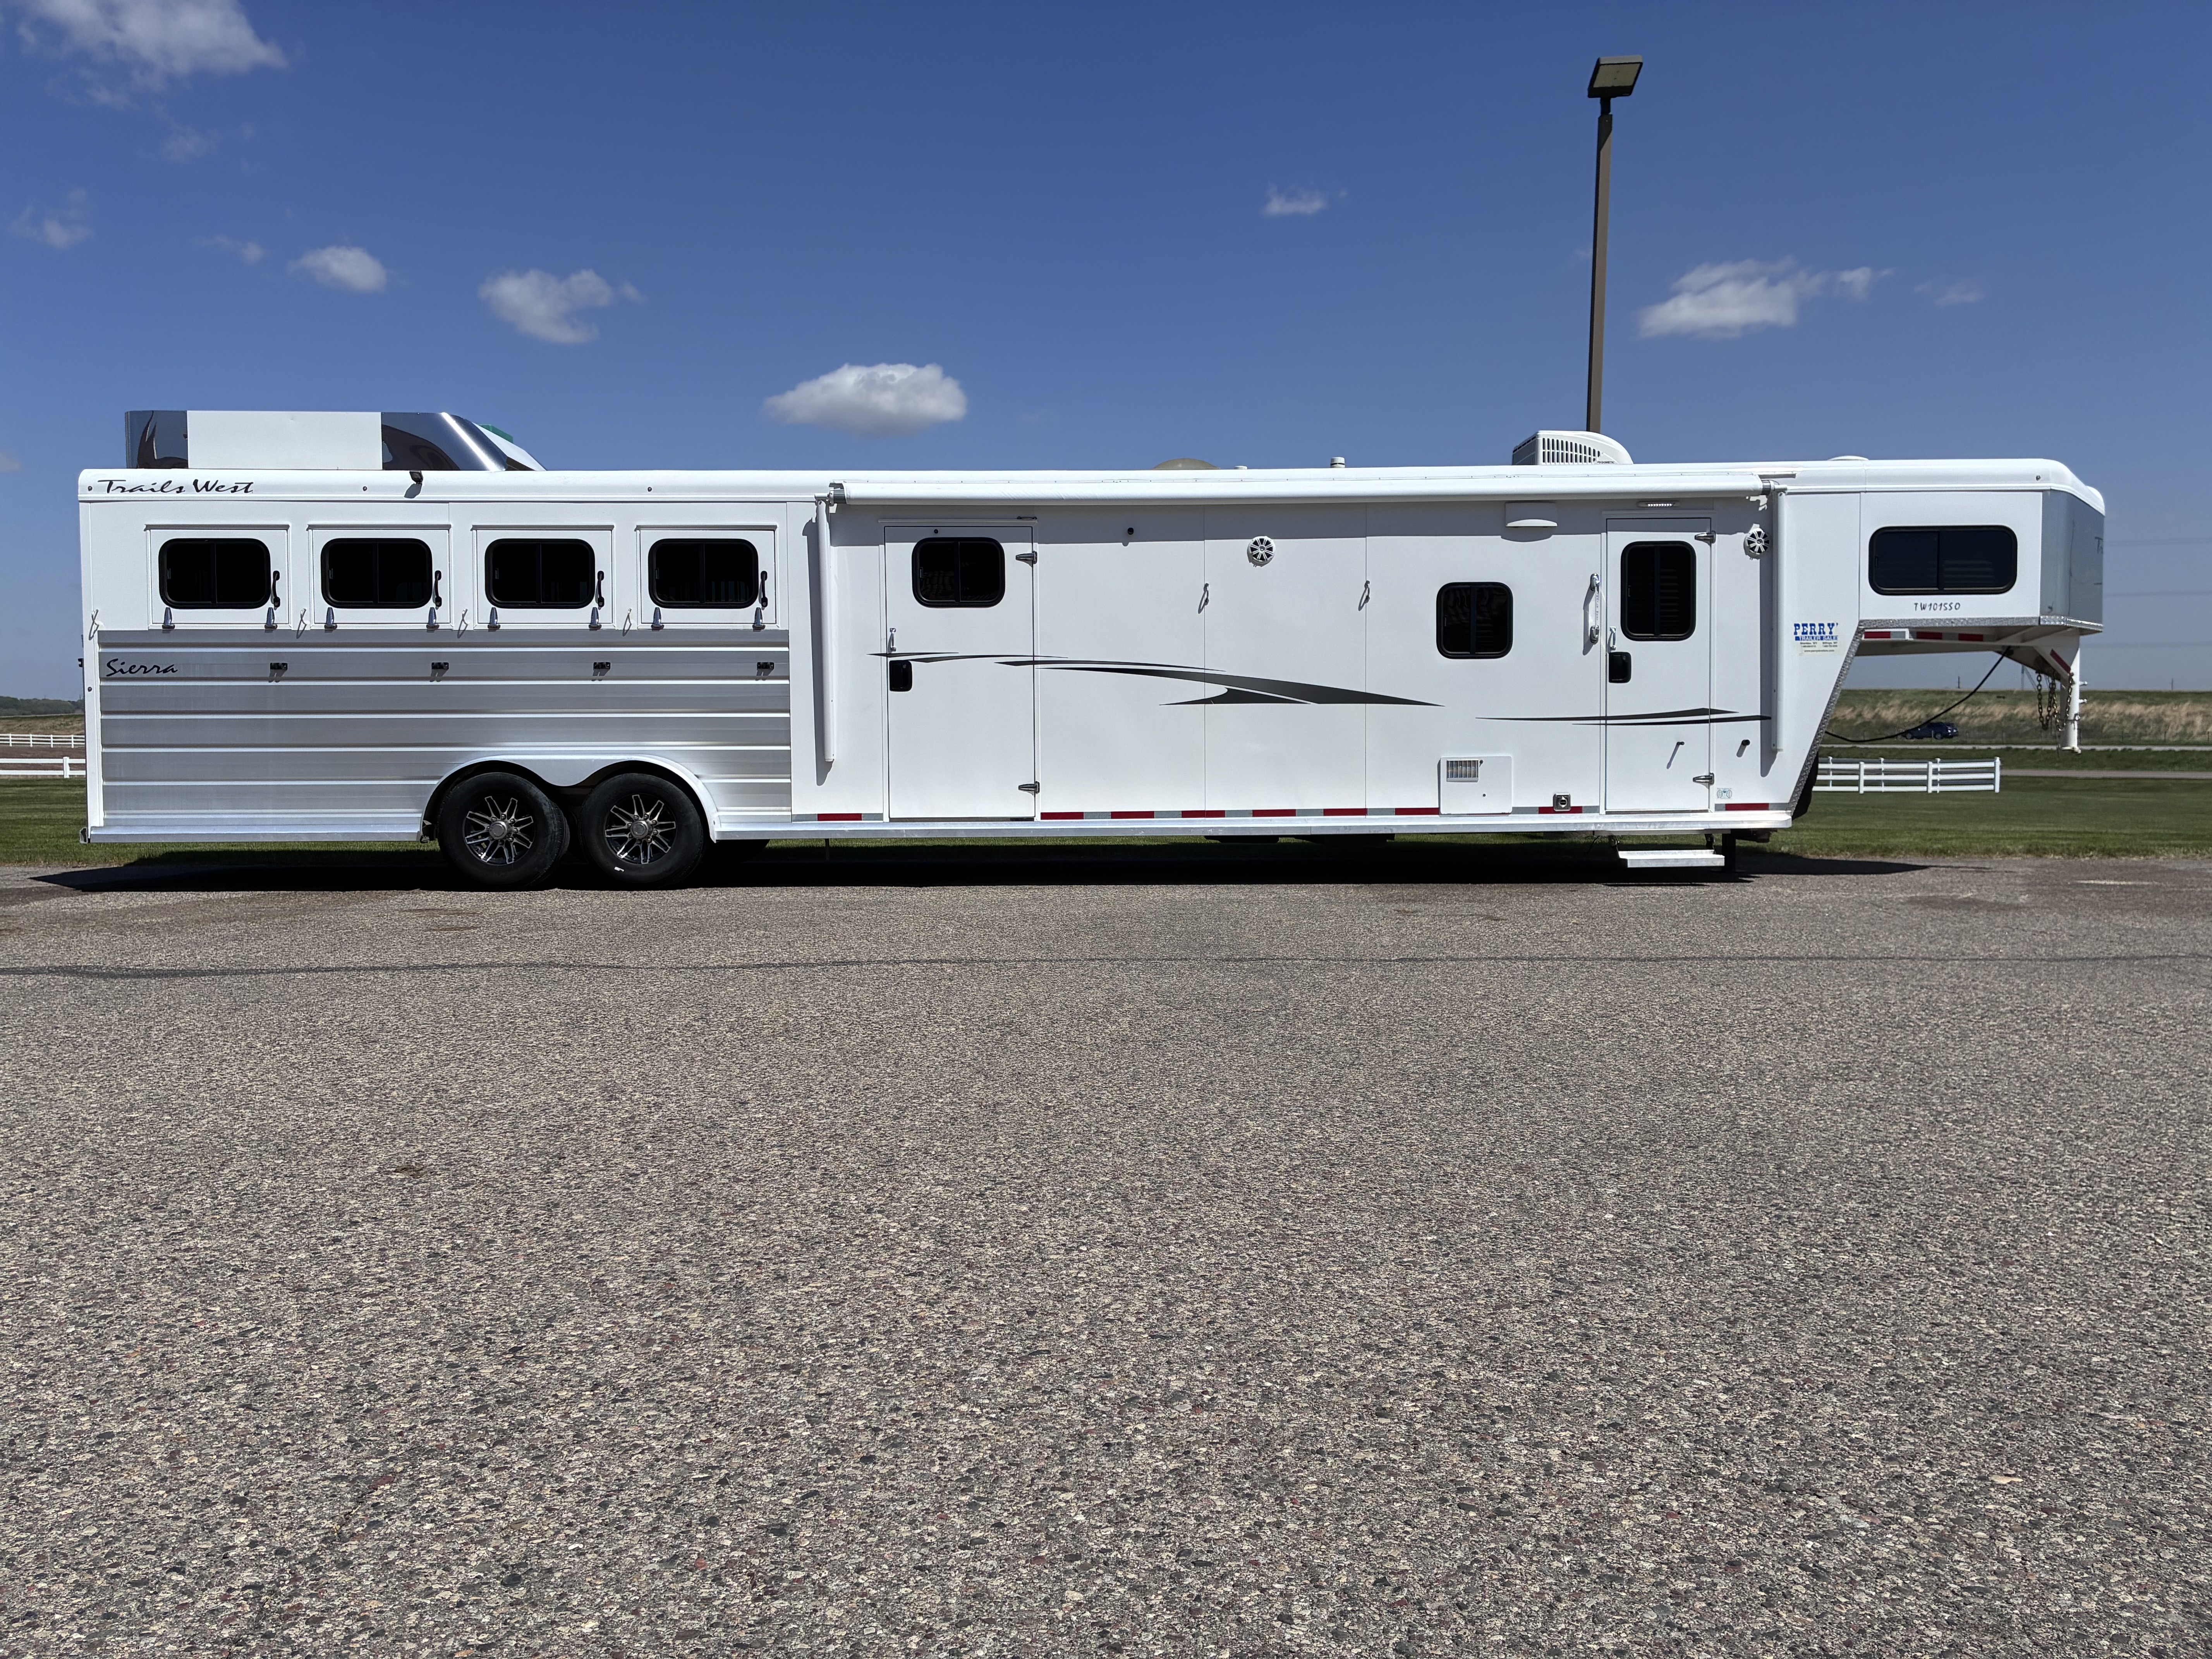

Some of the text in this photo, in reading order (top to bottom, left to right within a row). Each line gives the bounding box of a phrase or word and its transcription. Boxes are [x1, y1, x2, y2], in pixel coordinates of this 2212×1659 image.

[98, 479, 254, 494] Trails West
[106, 658, 178, 677] Sierra
